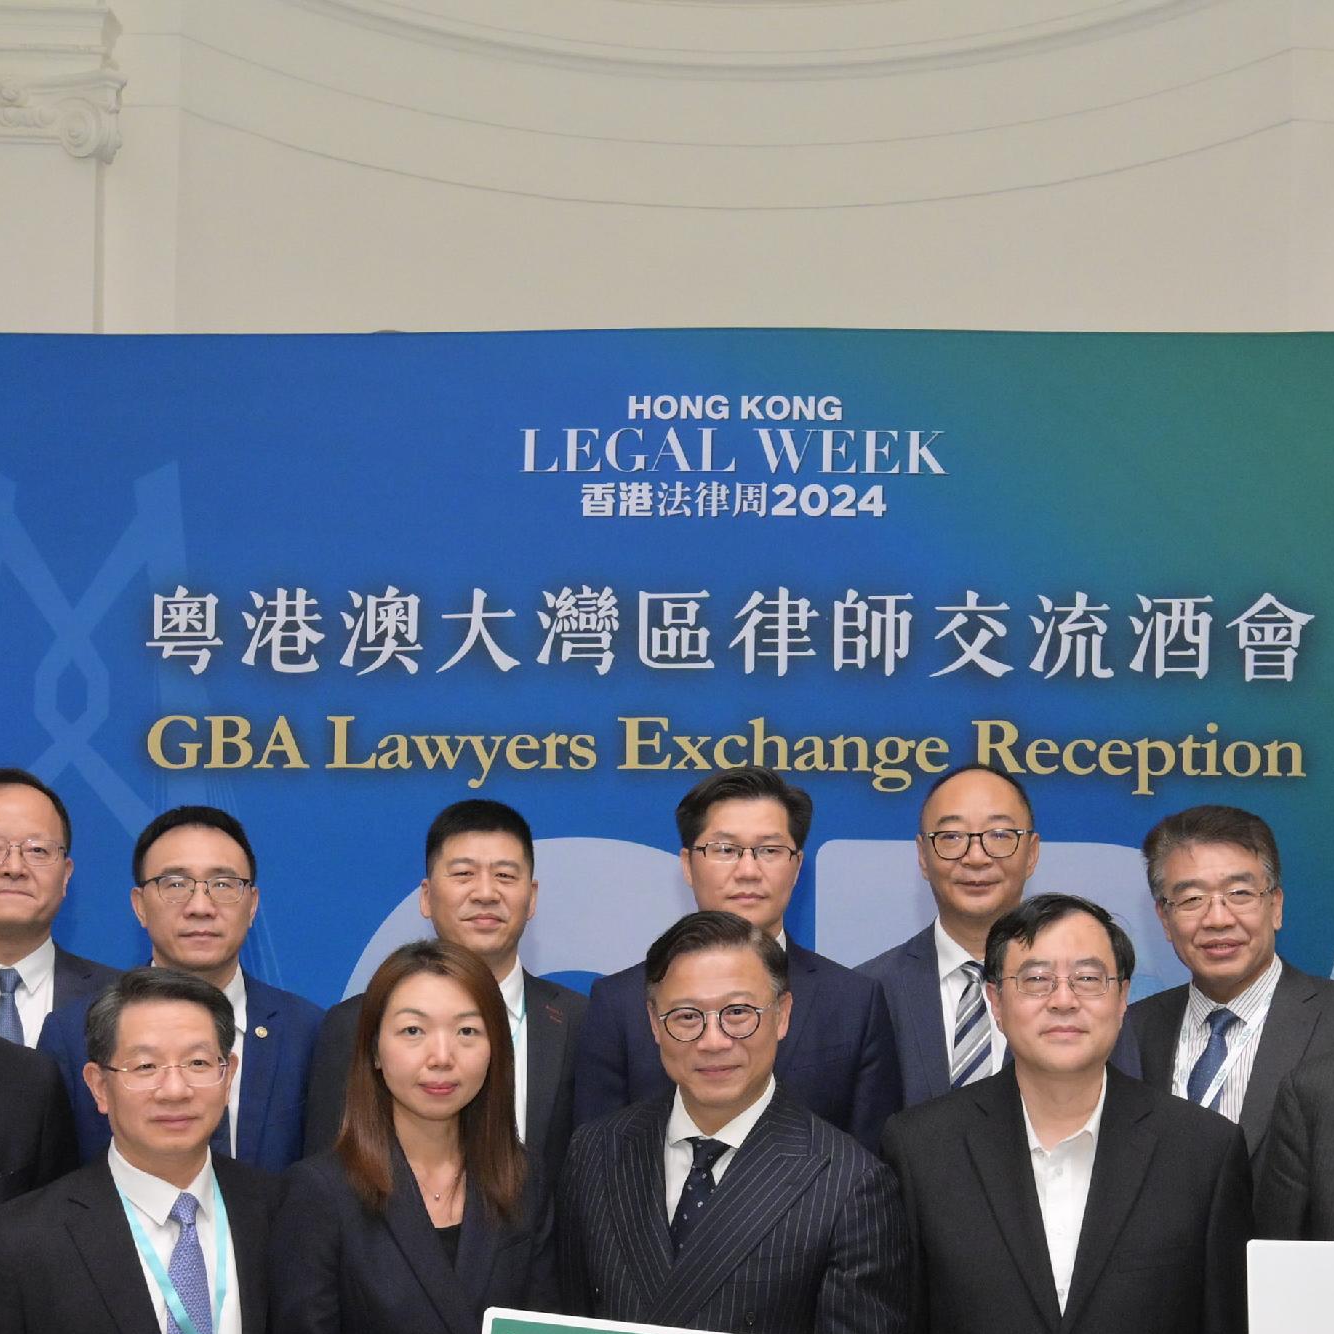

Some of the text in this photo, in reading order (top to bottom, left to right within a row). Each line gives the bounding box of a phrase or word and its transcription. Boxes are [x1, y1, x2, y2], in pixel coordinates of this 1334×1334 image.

[628, 395, 843, 421] HONG KONG
[522, 427, 950, 475] LEGAL WEEK
[146, 584, 1316, 682] 粵港澳大灣區律師交流酒會
[147, 715, 1307, 796] GBA Lawyers Exchange Reception
